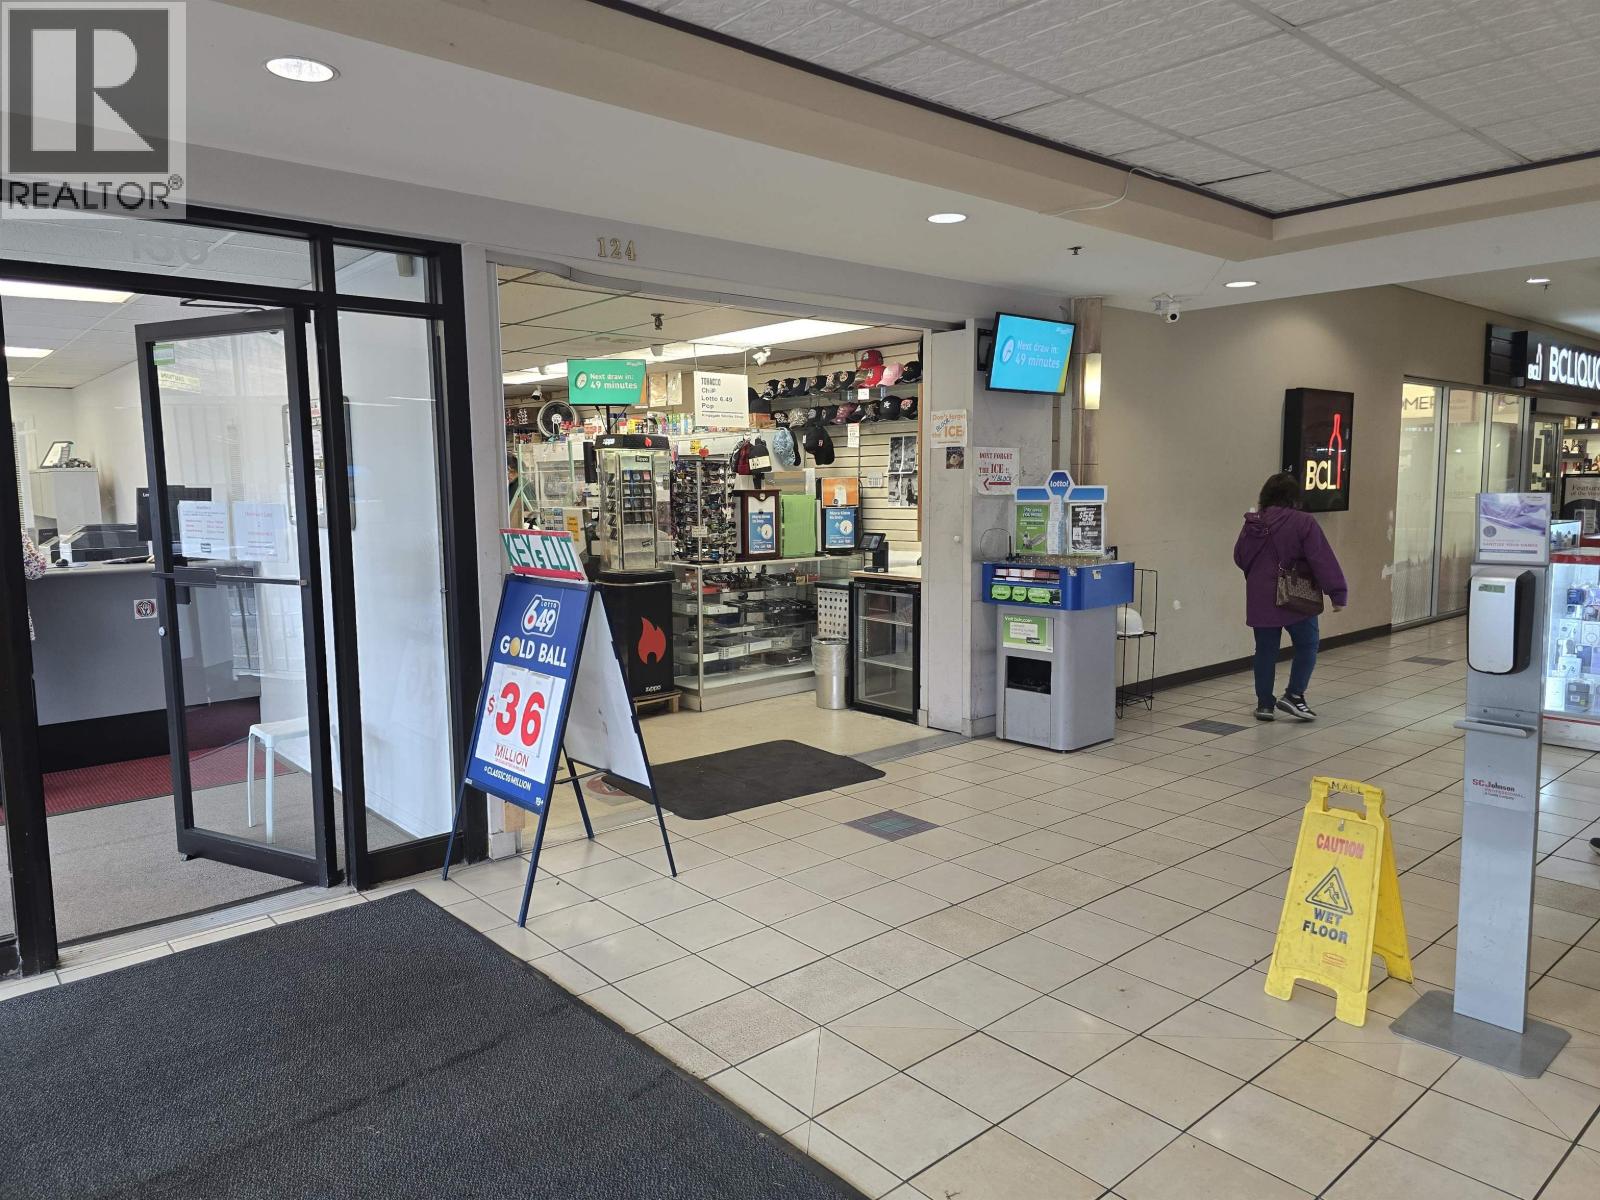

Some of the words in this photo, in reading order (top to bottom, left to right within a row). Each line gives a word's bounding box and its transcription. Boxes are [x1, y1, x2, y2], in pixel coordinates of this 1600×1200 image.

[597, 237, 637, 261] 124
[1016, 353, 1026, 365] 49
[1028, 355, 1060, 368] minutes
[590, 381, 601, 389] 49
[604, 381, 638, 389] minutes
[991, 463, 1004, 473] ICE
[541, 535, 578, 572] CUT
[540, 601, 557, 609] LOTTO
[538, 643, 567, 668] BALL
[494, 744, 530, 767] MILLION
[1486, 781, 1515, 792] Johnson
[1316, 833, 1364, 860] CAUTION
[1313, 907, 1343, 925] WET
[1302, 920, 1348, 945] FLOOR
